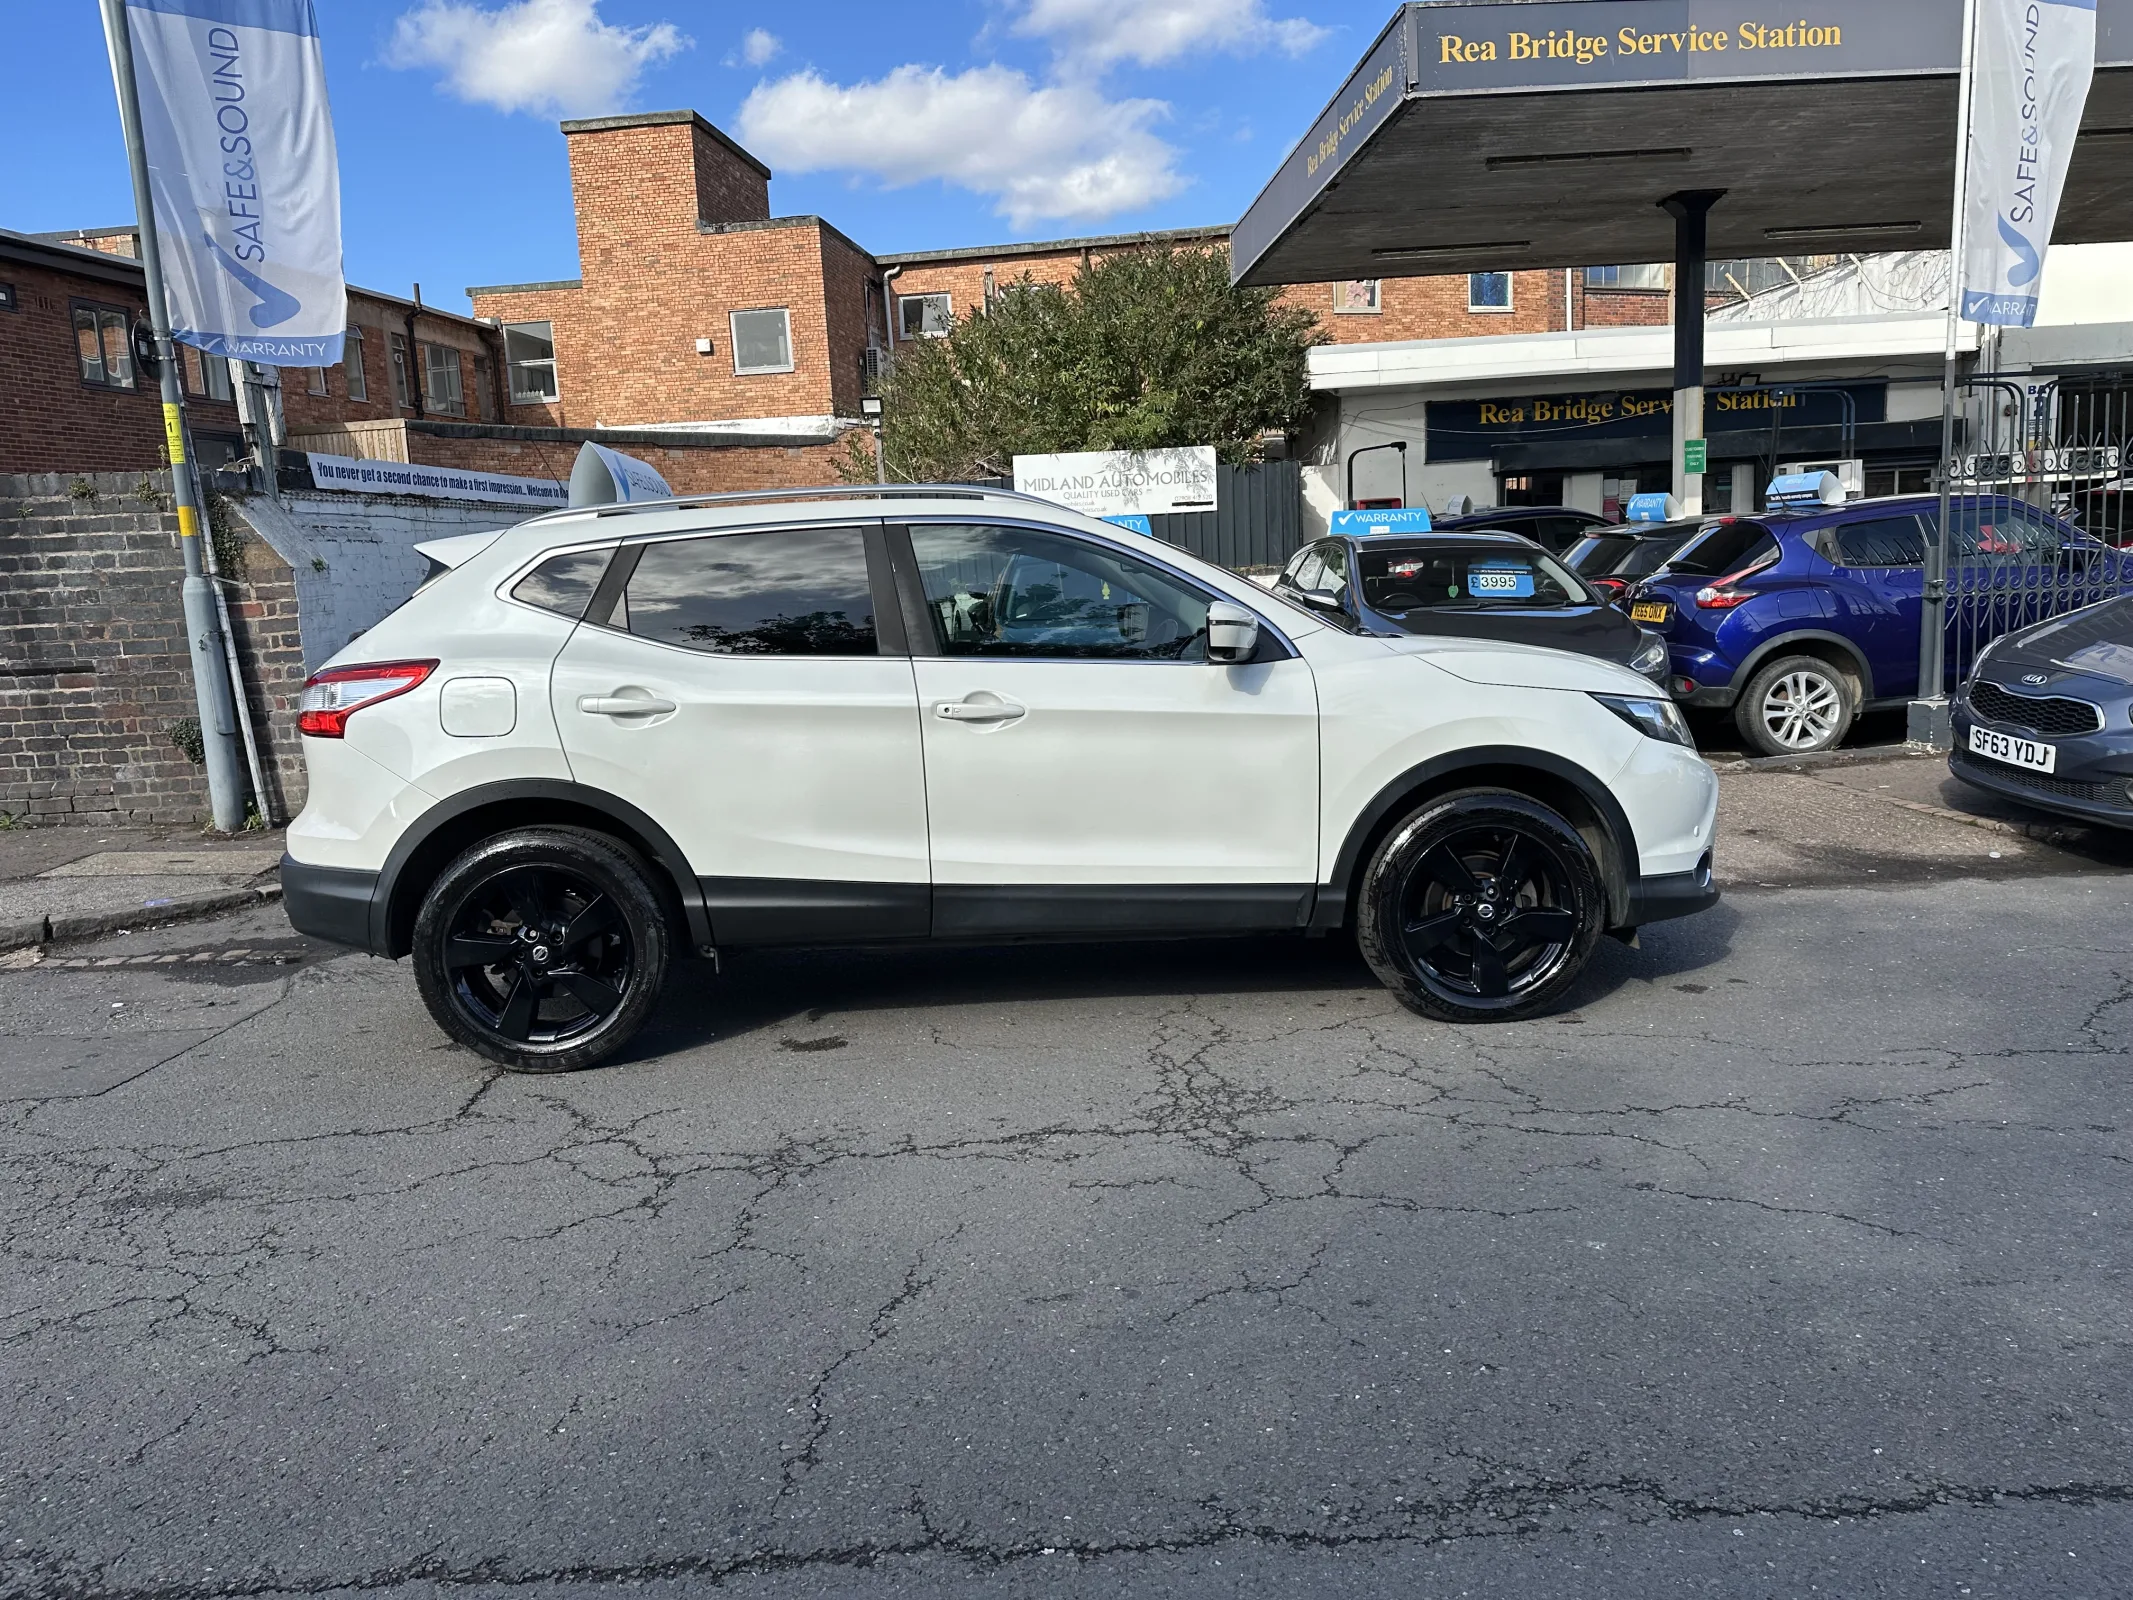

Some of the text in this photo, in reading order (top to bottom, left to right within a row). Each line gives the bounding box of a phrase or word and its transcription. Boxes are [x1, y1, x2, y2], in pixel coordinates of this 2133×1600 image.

[1439, 19, 1842, 65] Rea Bridge Service Station
[1307, 65, 1393, 178] Rea Bridge Service Station
[2010, 3, 2040, 223] SAFE&SOUND
[208, 27, 265, 263] SAFE&SOUND
[222, 340, 327, 357] WARRANTY
[1479, 403, 1524, 425] Rea
[1532, 398, 1614, 424] Bridge
[1621, 394, 1705, 416] Serv
[167, 421, 173, 433] 1
[316, 461, 334, 478] You
[335, 466, 360, 481] never
[361, 468, 376, 483] get
[376, 470, 382, 482] a
[383, 471, 412, 486] second
[412, 472, 440, 487] chance
[440, 476, 448, 488] to
[449, 477, 468, 490] make
[468, 480, 474, 491] a
[473, 478, 489, 492] first
[526, 484, 553, 498] Welcome
[553, 487, 560, 499] to
[1023, 469, 1208, 492] MIDLAND AUTOMOBILES
[1063, 488, 1143, 501] QUALITY USED CARS
[1355, 511, 1422, 523] WARRANTY
[2024, 674, 2043, 683] KIA
[1975, 729, 2049, 766] SF63 YDJ
